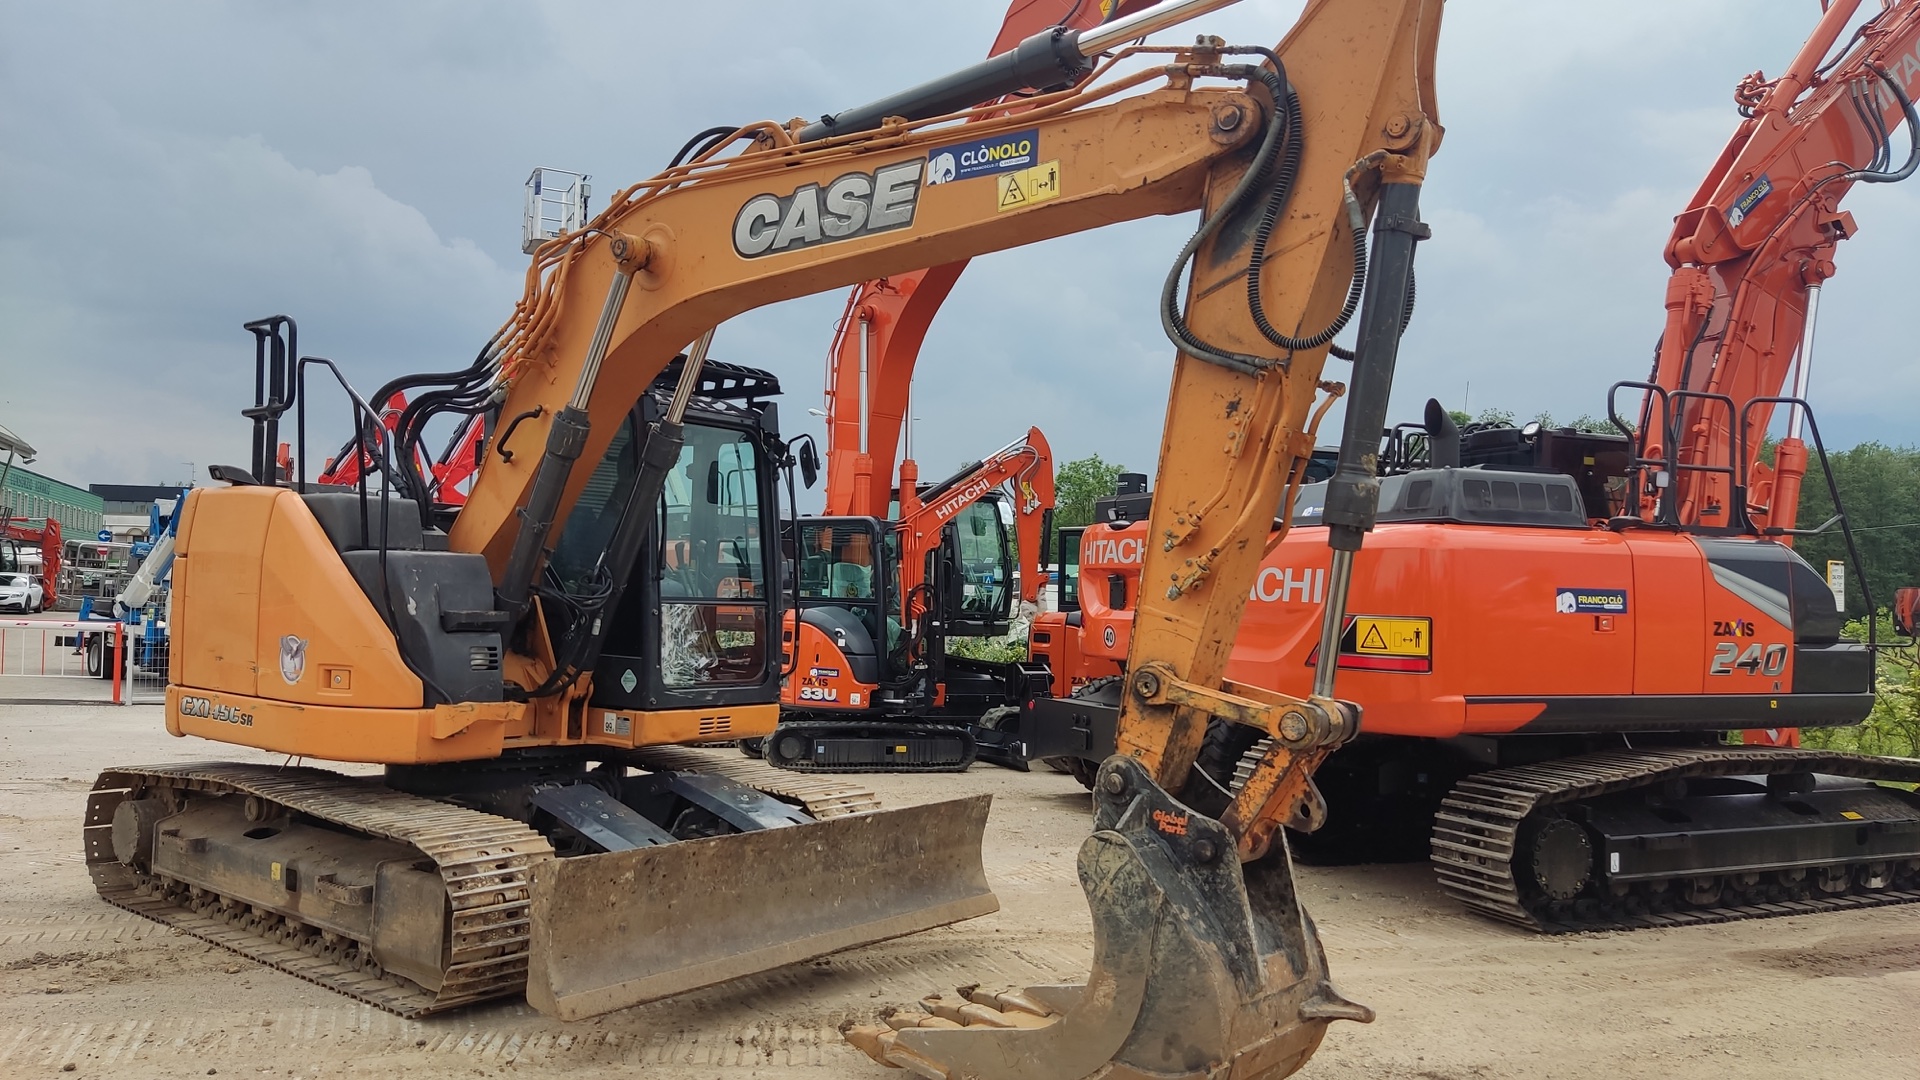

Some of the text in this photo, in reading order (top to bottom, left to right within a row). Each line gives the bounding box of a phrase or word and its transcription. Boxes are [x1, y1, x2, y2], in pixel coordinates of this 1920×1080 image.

[961, 140, 1031, 166] CLÒNOLO
[735, 163, 922, 255] CASE
[935, 478, 991, 519] HITACHI
[1577, 594, 1623, 605] FRANCO CLÒ
[1713, 619, 1755, 637] ZAXIS
[1105, 631, 1114, 643] 40
[1710, 642, 1788, 676] 240
[802, 676, 829, 687] ZAXIS
[801, 687, 837, 701] 33U
[241, 713, 254, 727] SR
[1153, 810, 1188, 825] Global
[1159, 821, 1188, 835] Parts
